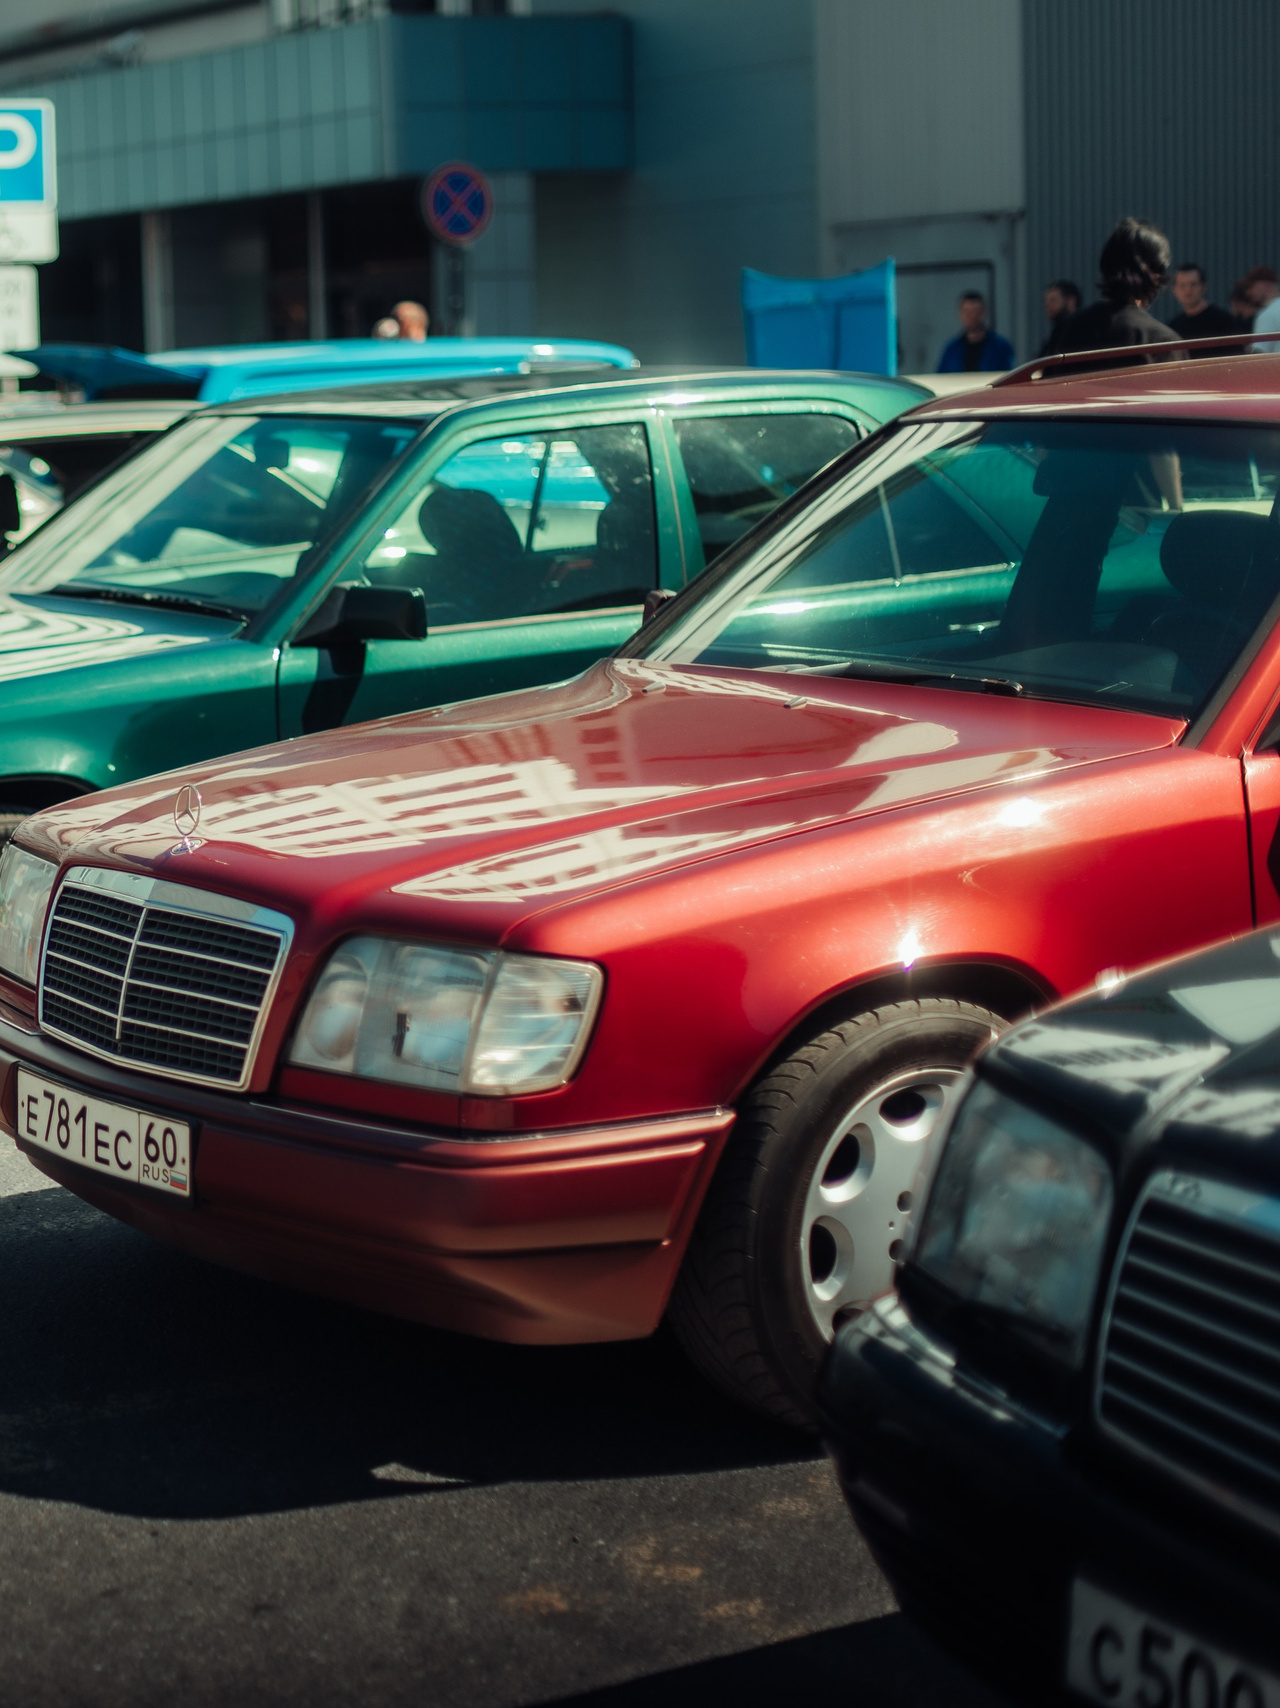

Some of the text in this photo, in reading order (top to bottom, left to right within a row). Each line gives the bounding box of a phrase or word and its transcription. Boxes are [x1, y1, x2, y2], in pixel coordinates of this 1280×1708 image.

[26, 1089, 178, 1171] E781EC 60
[142, 1163, 170, 1185] RUS
